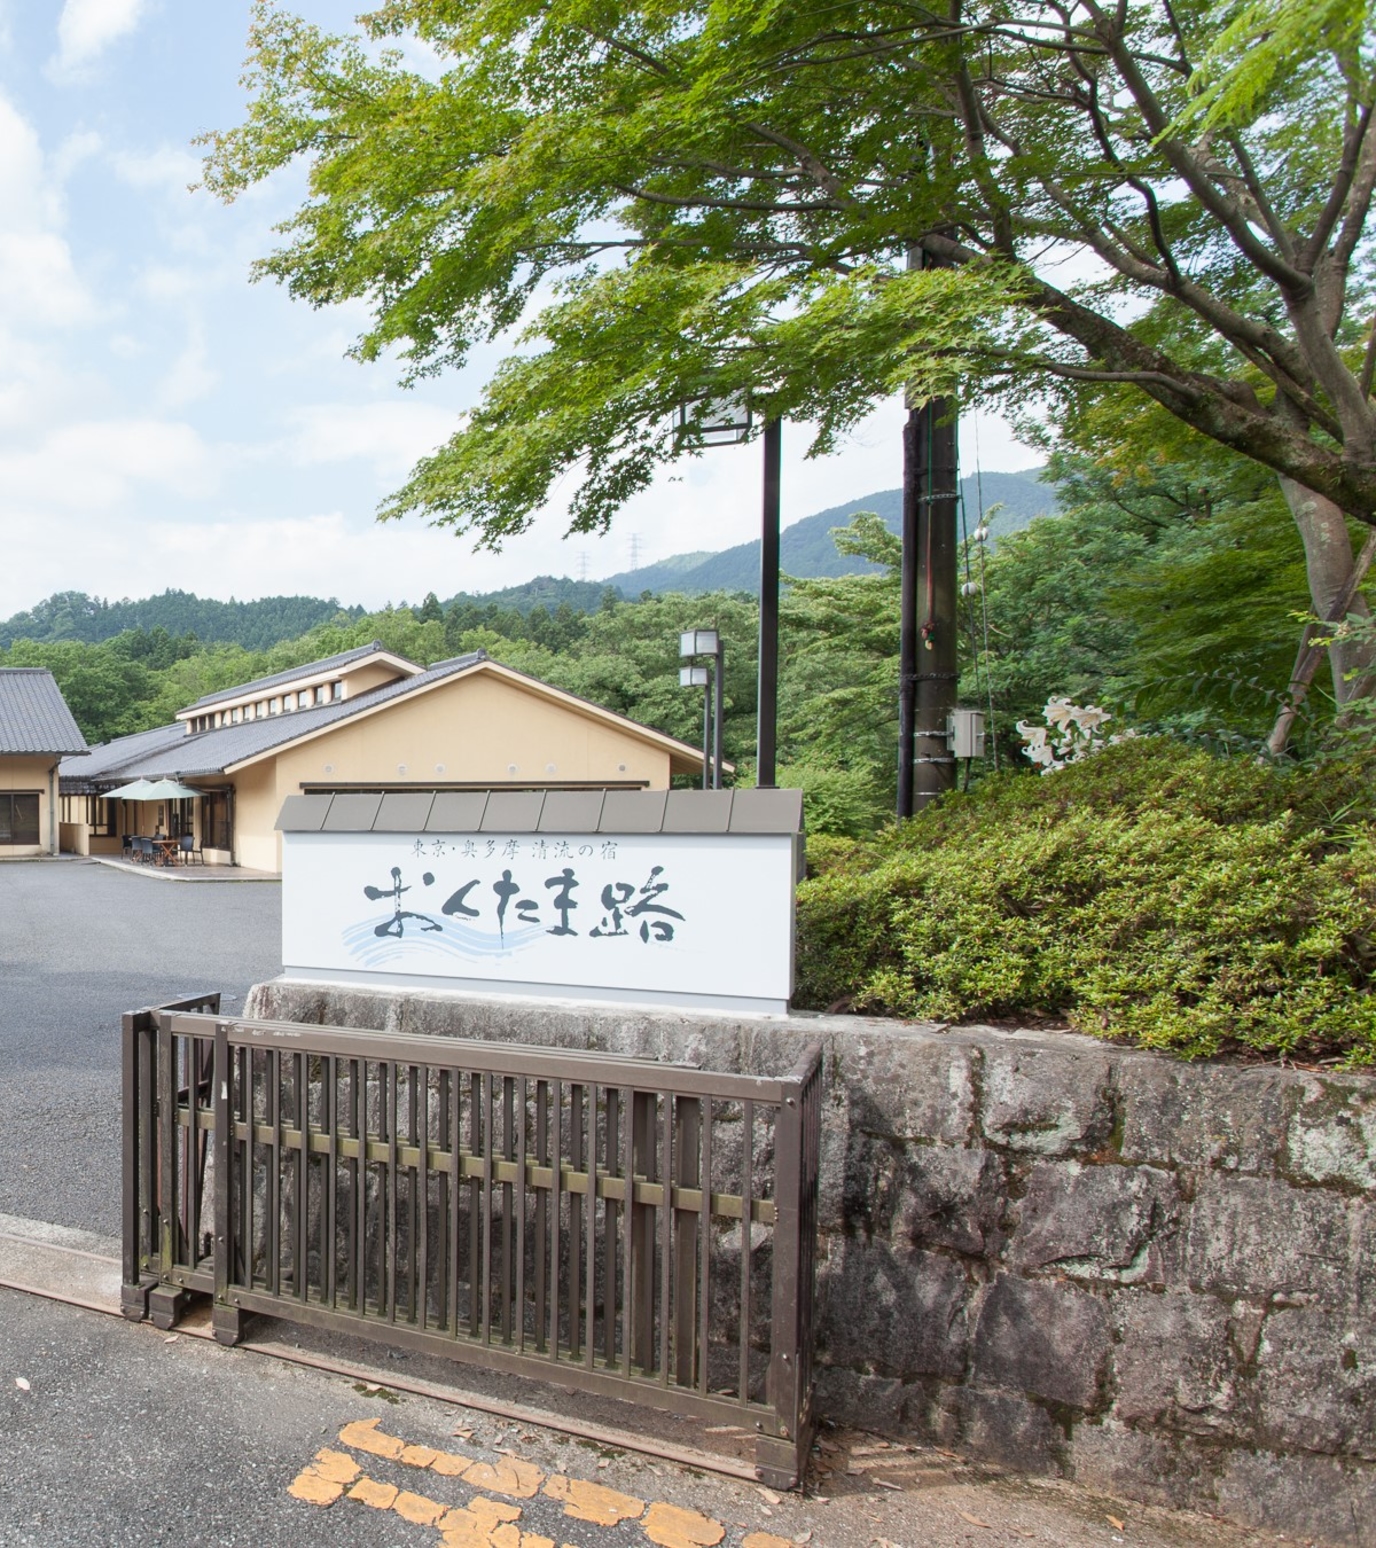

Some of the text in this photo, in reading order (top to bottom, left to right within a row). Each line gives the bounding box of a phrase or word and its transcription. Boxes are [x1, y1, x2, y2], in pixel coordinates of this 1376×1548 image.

[364, 866, 686, 949] おくたま路
